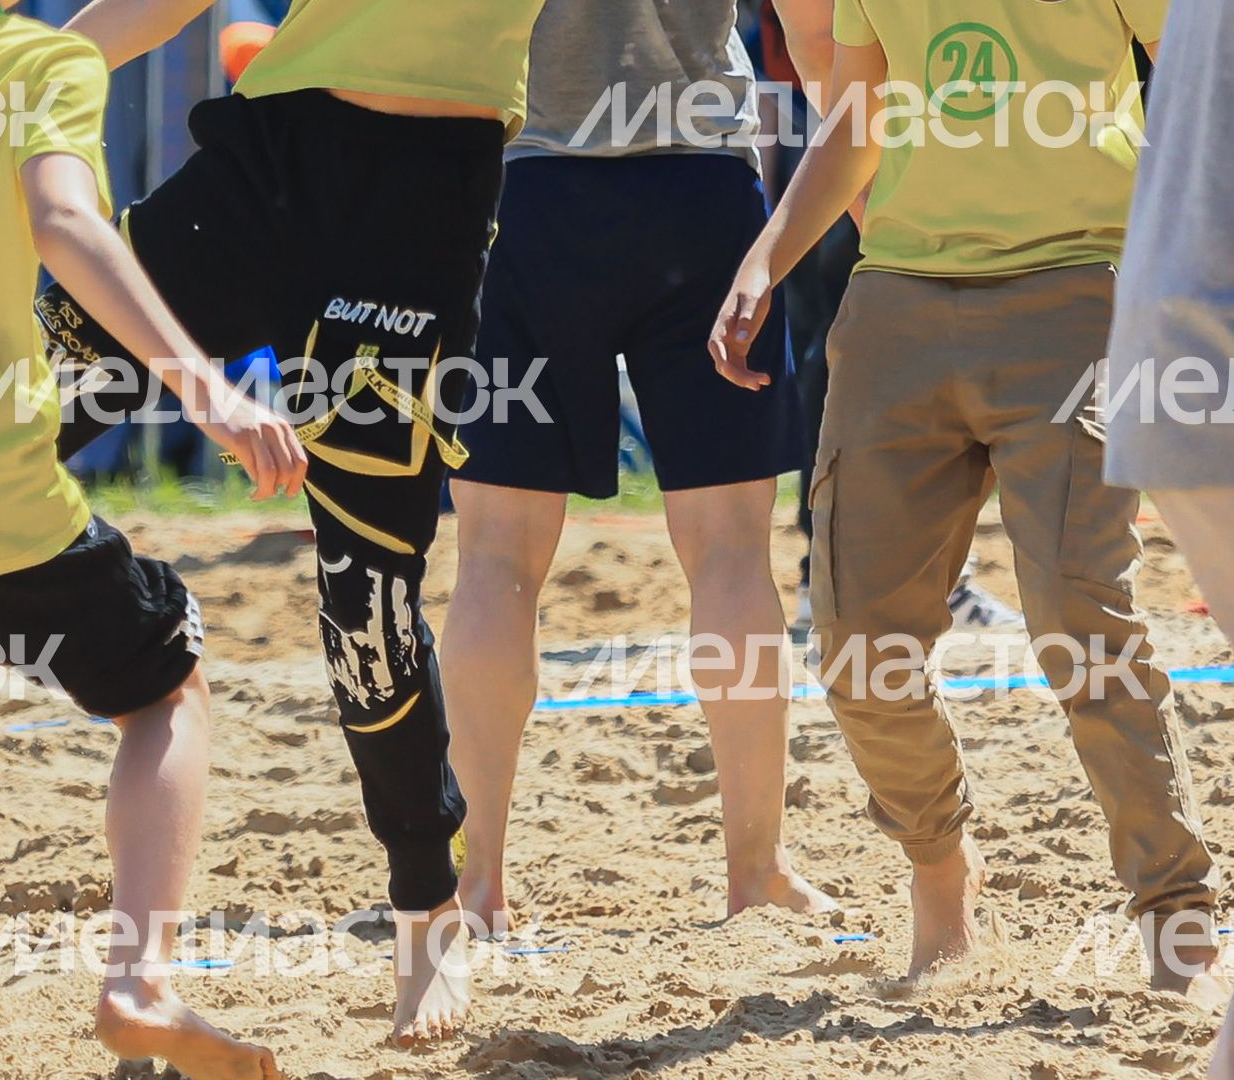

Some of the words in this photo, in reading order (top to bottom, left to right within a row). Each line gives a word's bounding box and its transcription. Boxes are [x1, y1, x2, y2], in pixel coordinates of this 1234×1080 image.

[942, 40, 997, 98] 24
[324, 297, 377, 324] BUT
[374, 304, 437, 337] NOT
